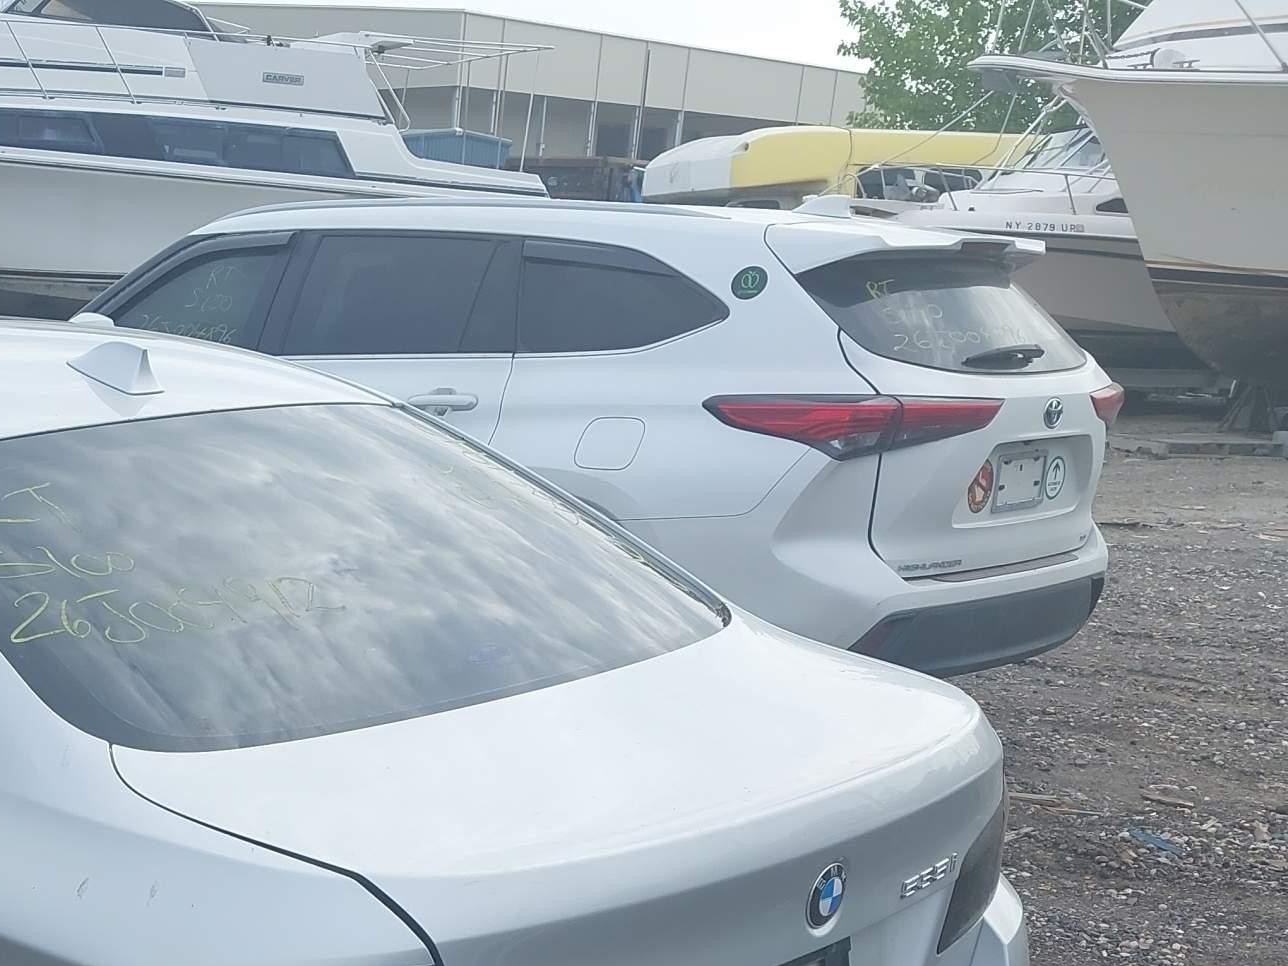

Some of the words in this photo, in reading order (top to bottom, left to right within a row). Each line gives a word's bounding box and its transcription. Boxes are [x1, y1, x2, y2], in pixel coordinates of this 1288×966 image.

[1005, 221, 1022, 230] NY
[1027, 222, 1056, 232] 2879
[865, 279, 895, 300] RT
